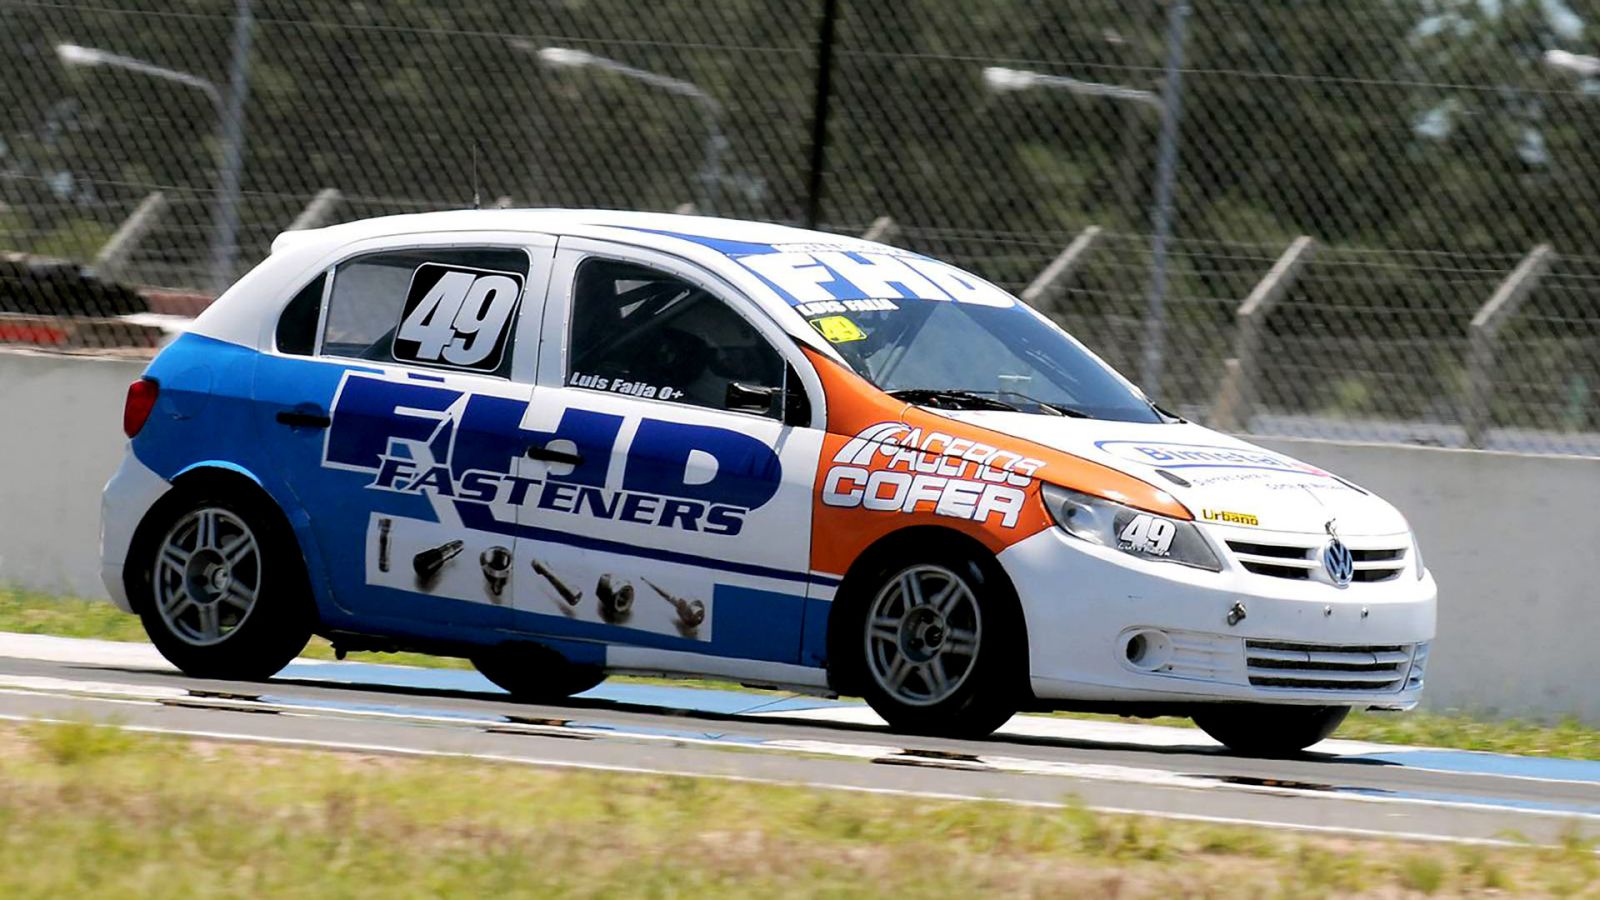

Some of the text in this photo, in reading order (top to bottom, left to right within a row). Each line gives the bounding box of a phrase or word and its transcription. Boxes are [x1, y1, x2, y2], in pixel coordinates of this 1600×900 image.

[738, 251, 1016, 308] FHD
[397, 271, 518, 365] 49
[570, 372, 608, 391] Luis
[611, 378, 656, 399] Faija
[325, 372, 783, 512] FHD
[887, 427, 1048, 487] ACEROS
[368, 459, 750, 537] FASTENERS
[821, 465, 1026, 529] COFER
[1202, 508, 1259, 526] Urbano
[1120, 514, 1177, 556] 49
